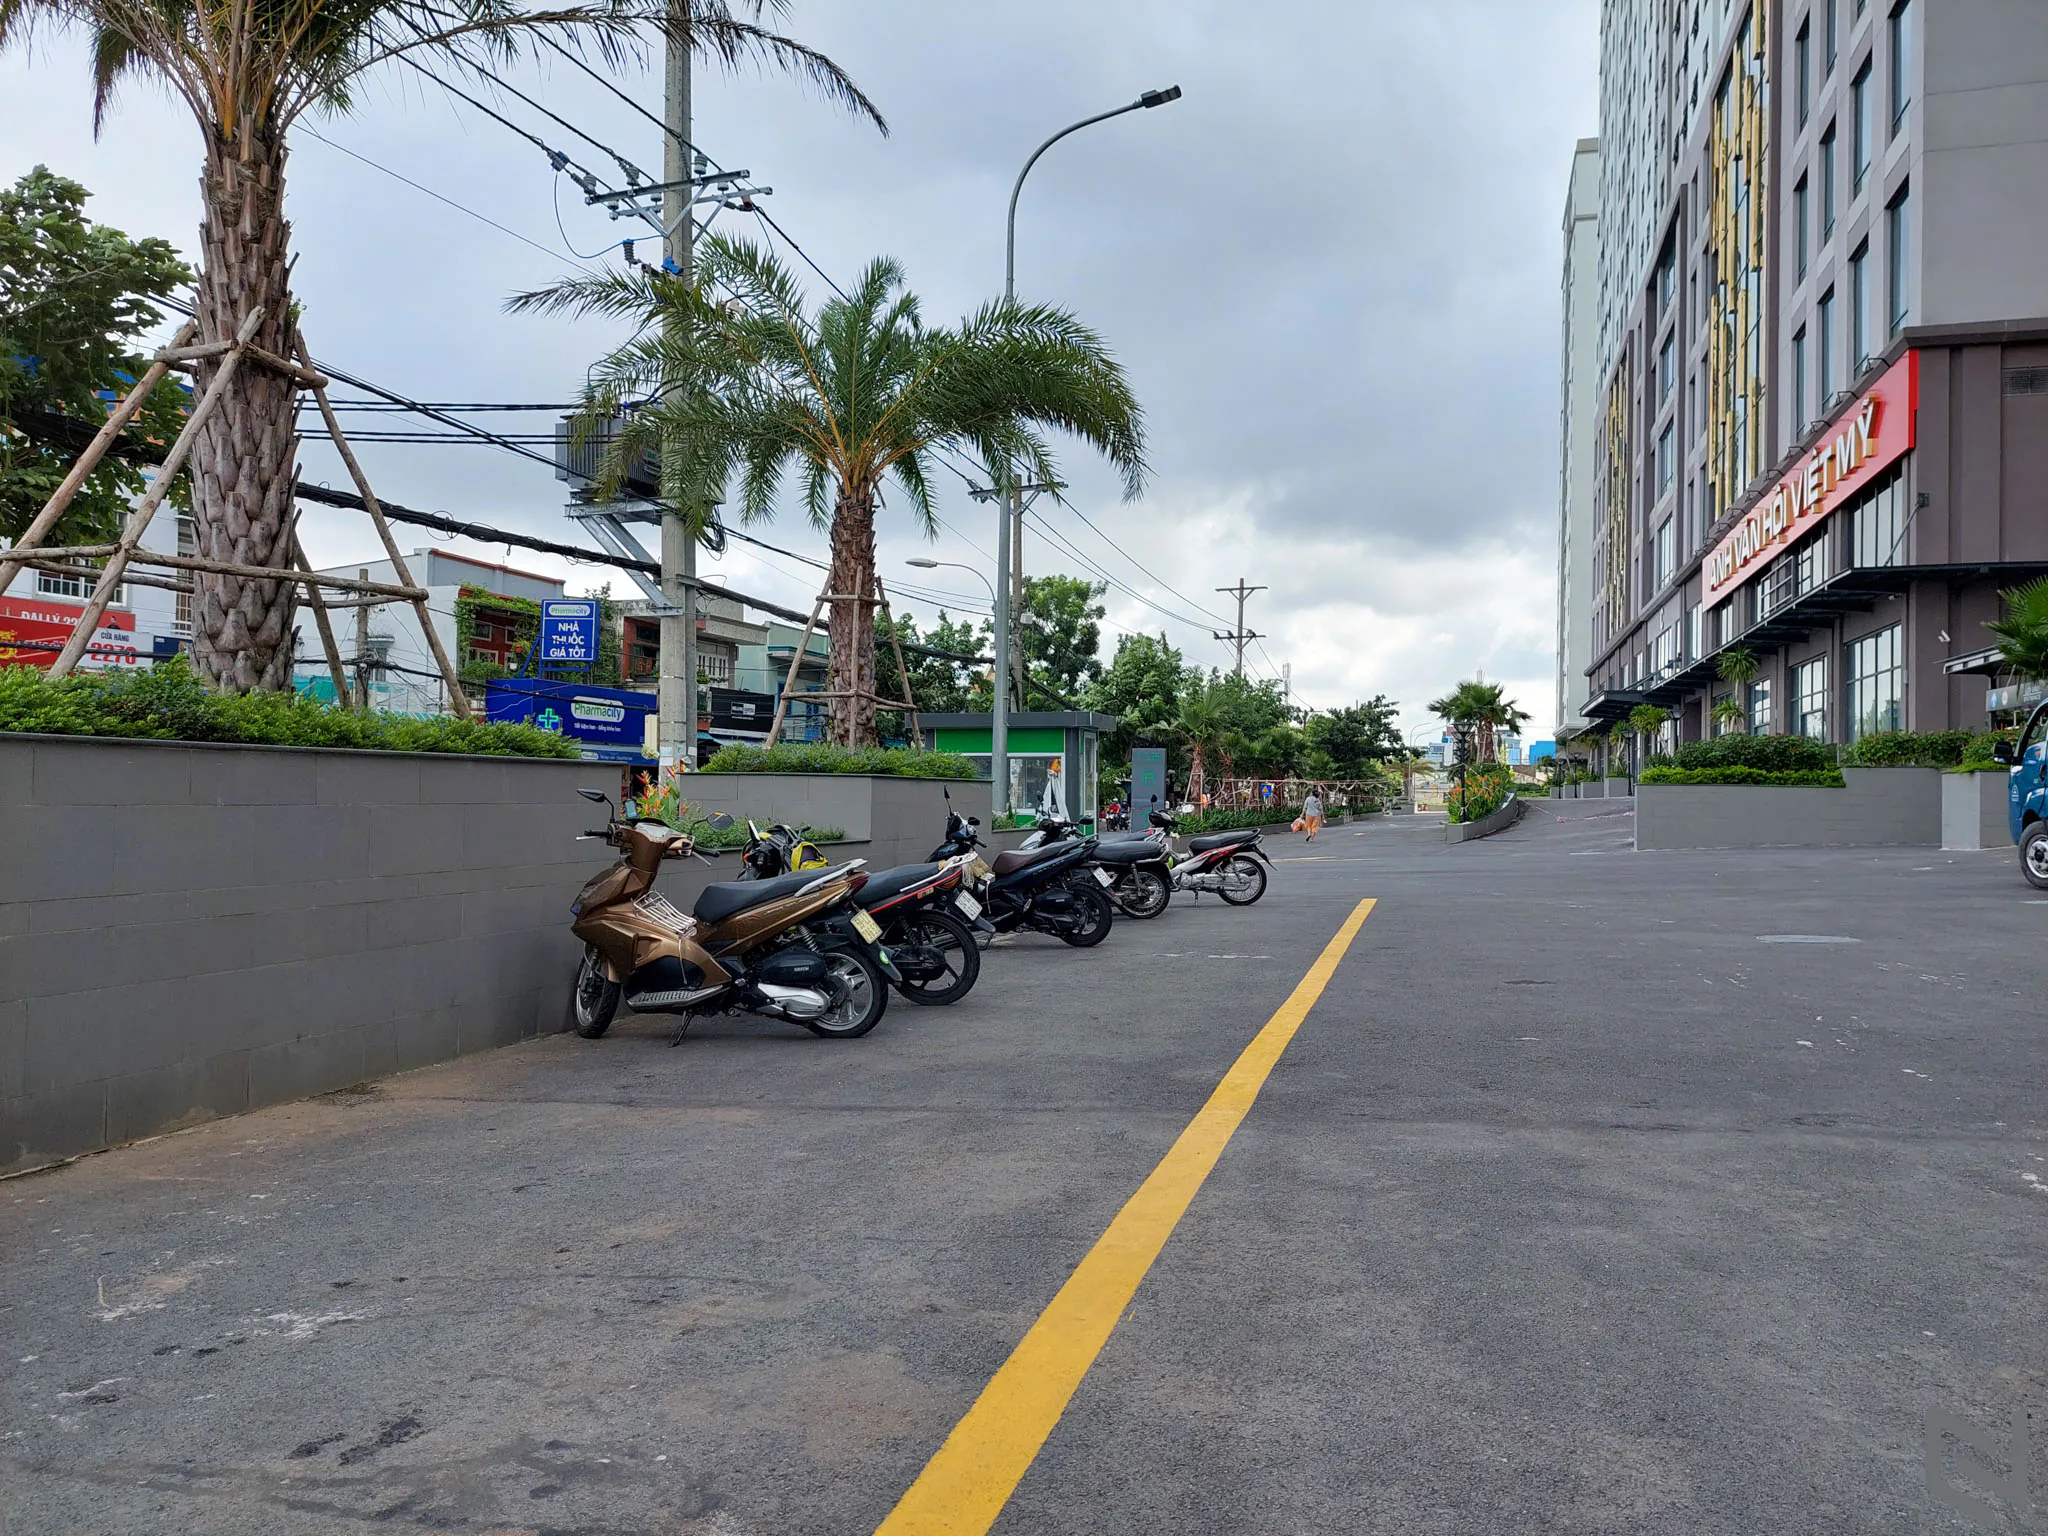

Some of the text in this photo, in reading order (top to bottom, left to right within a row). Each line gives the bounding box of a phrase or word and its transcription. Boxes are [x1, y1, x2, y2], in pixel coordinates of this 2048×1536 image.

[1710, 394, 1877, 591] ANH VĂN HỘI VIỆT MỸ
[558, 620, 579, 632] NHÀ
[552, 632, 585, 645] THUỐC
[550, 644, 586, 658] GIÁ TỐT
[574, 701, 622, 720] Pharmacity
